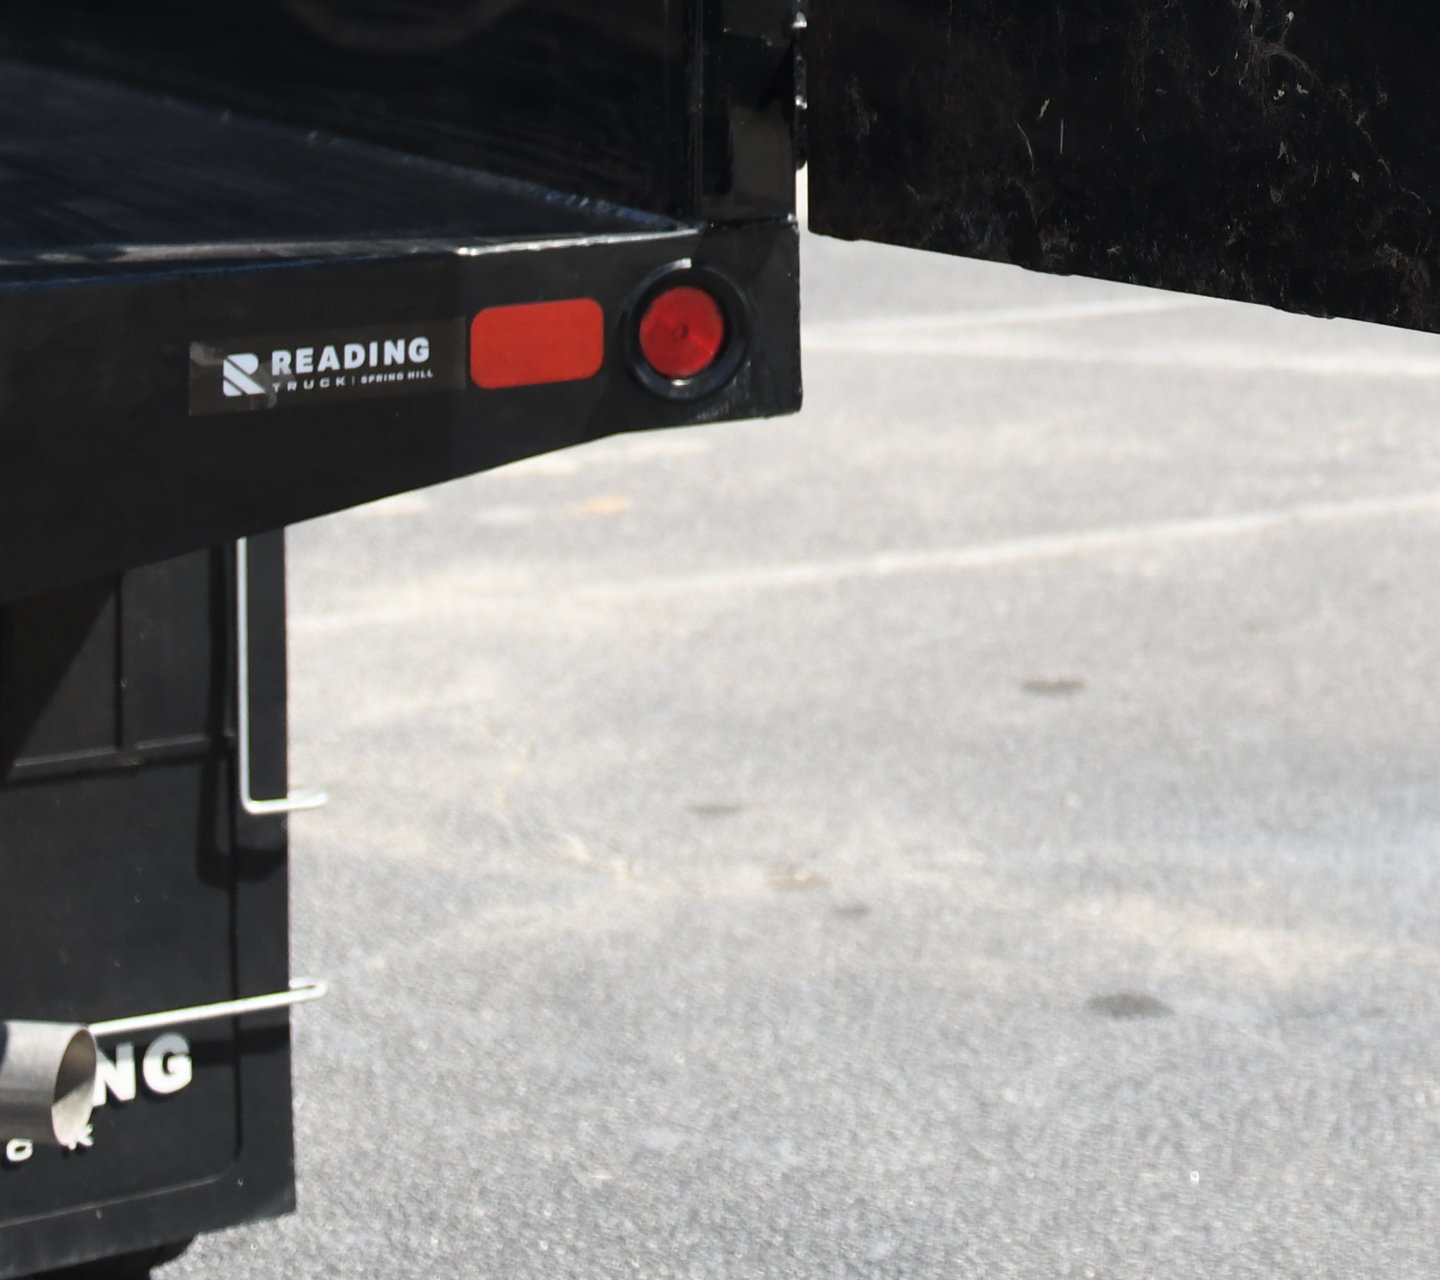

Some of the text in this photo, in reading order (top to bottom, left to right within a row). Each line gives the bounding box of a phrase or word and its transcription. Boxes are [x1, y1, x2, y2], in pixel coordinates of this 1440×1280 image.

[271, 336, 430, 376] READING
[272, 367, 434, 393] TRUCK SPRING HILL
